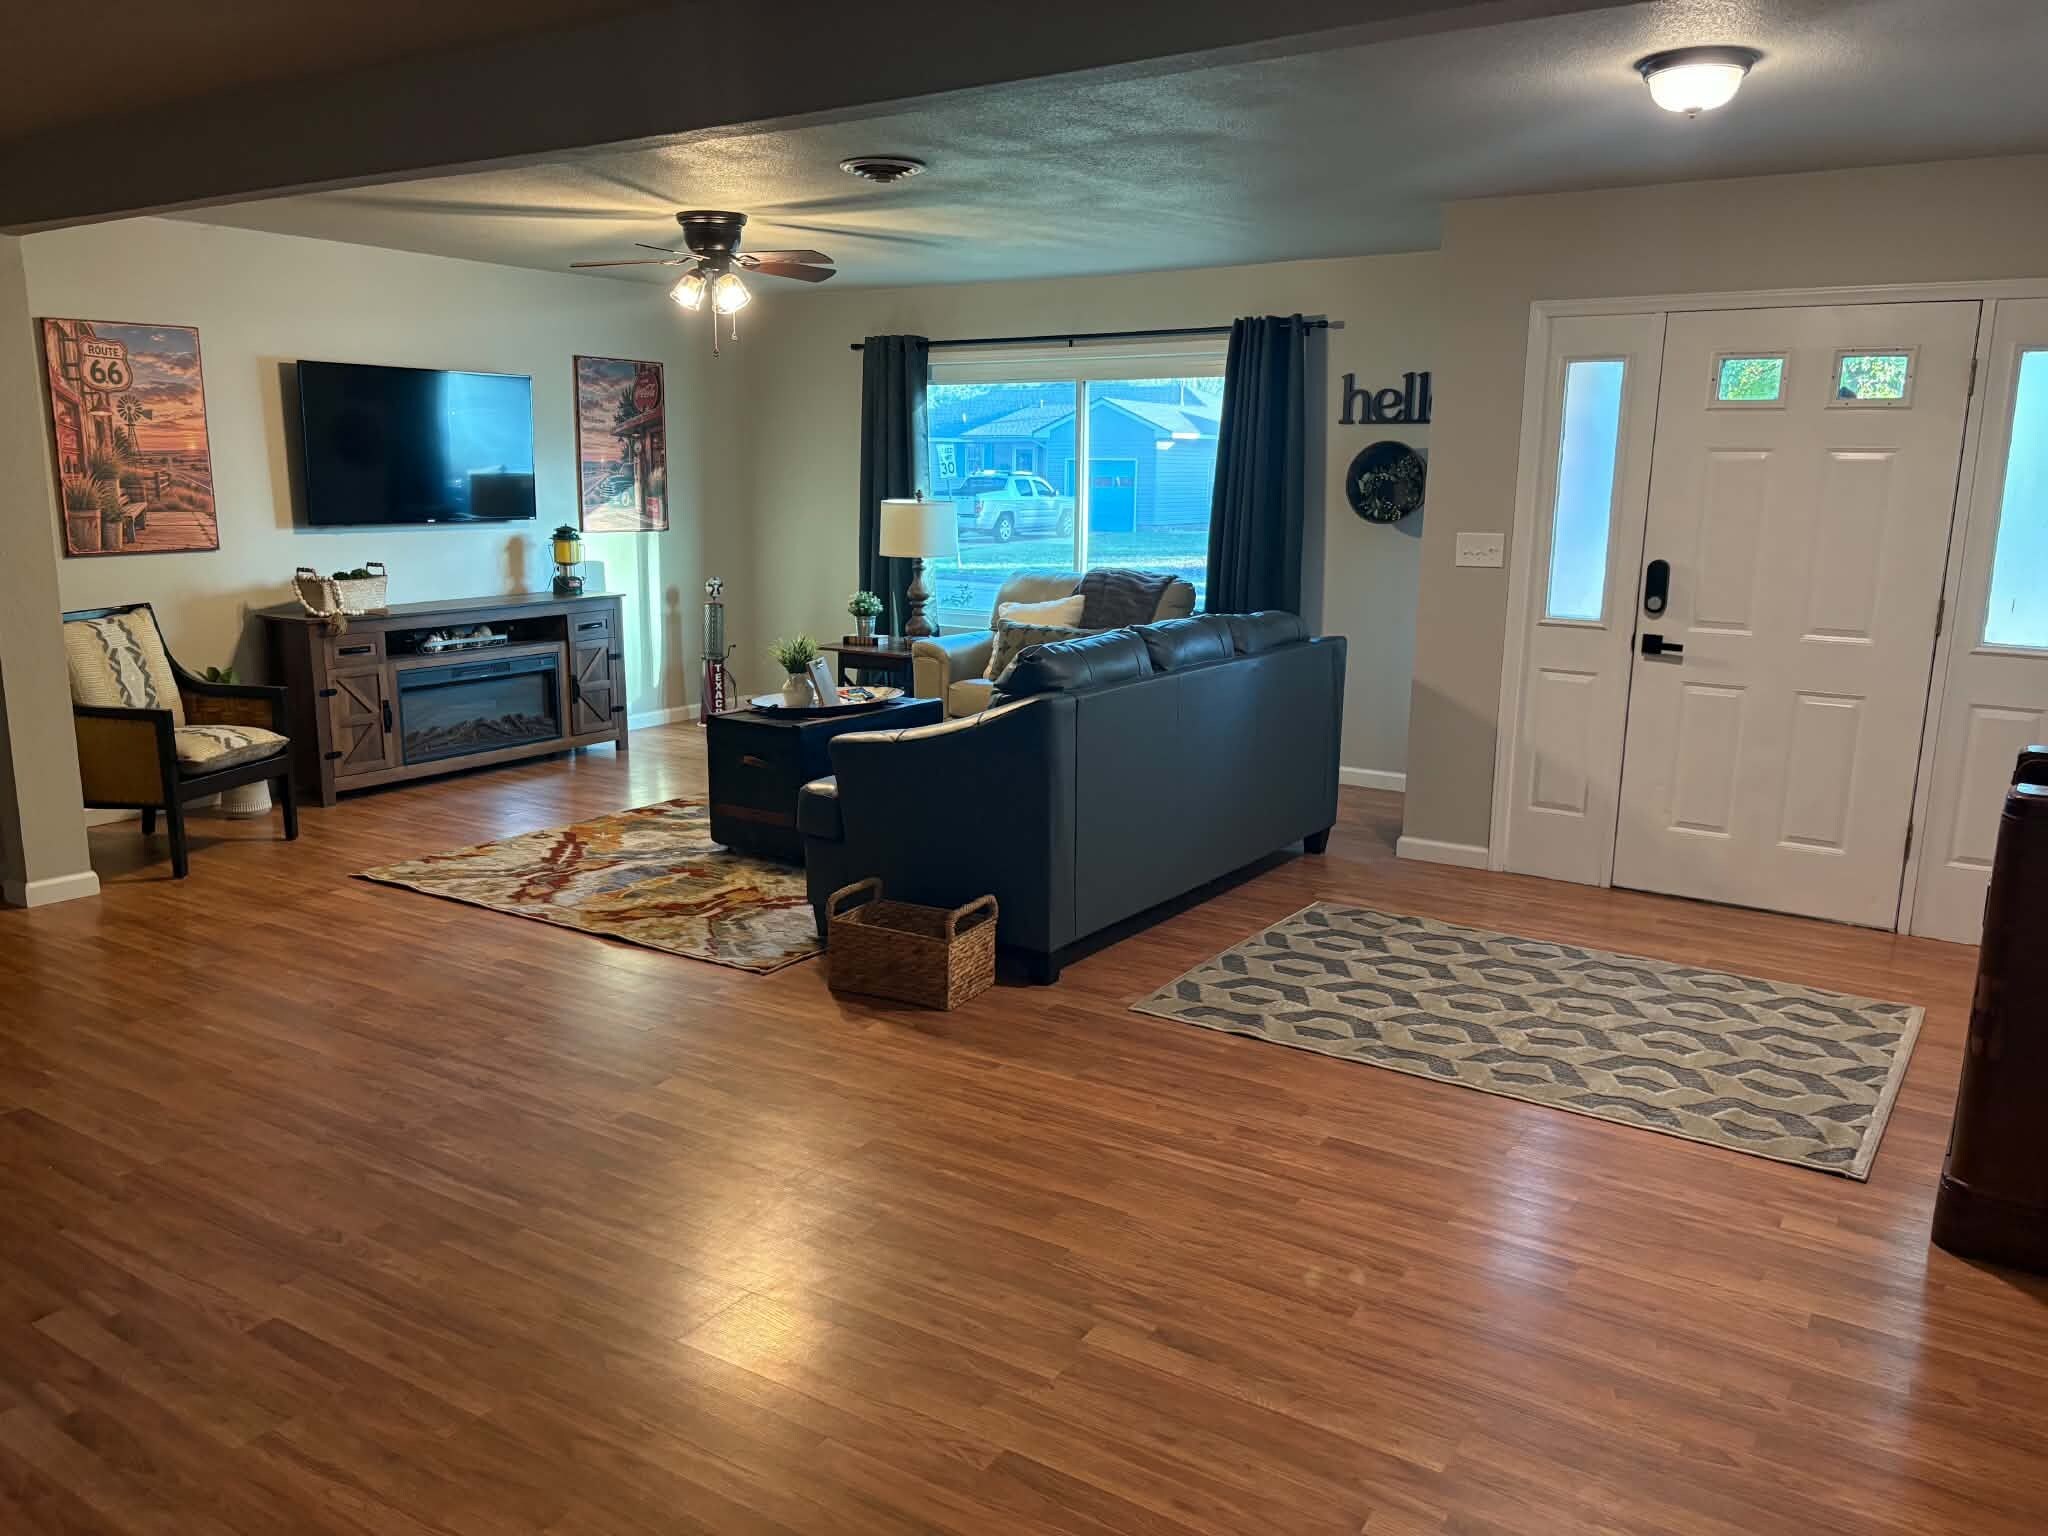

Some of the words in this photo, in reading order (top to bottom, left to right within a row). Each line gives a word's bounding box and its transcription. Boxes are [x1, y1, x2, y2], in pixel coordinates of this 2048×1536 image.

[88, 344, 120, 357] ROUTE
[90, 359, 123, 385] 66
[1338, 371, 1432, 424] hell
[941, 462, 954, 474] 30
